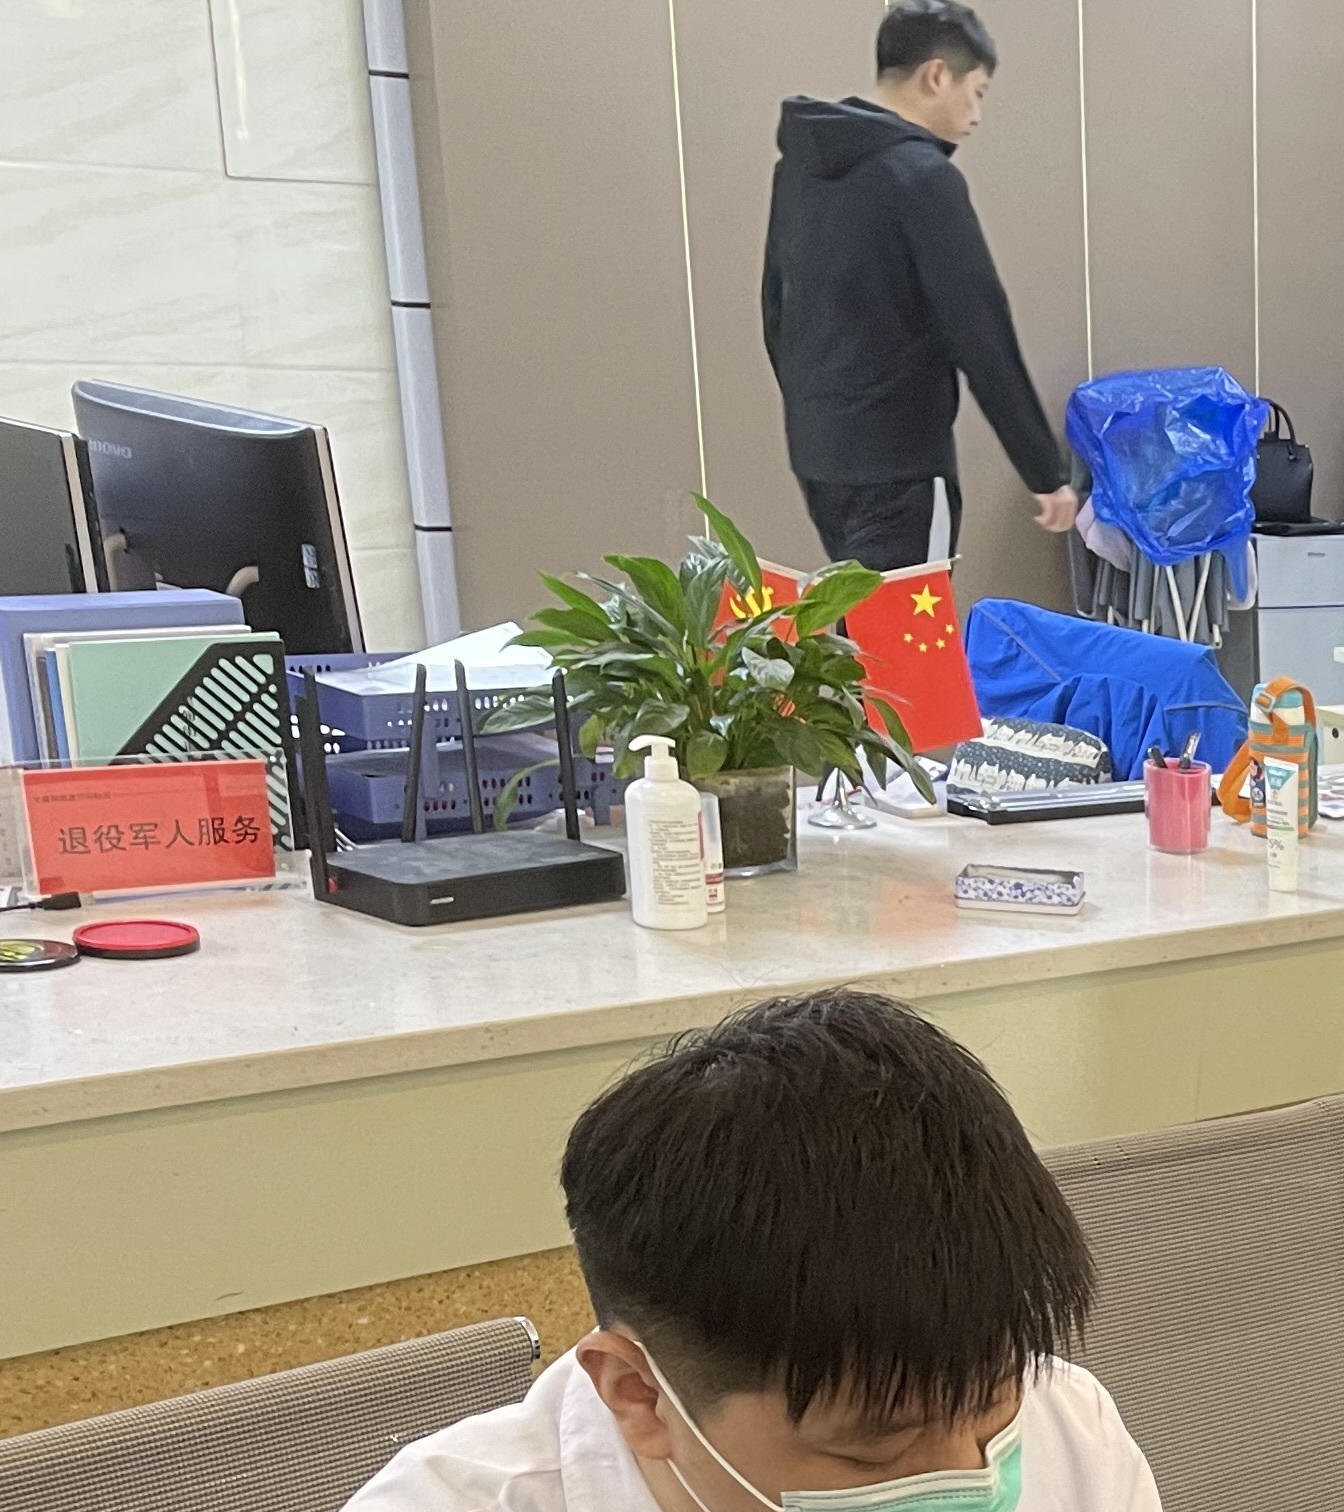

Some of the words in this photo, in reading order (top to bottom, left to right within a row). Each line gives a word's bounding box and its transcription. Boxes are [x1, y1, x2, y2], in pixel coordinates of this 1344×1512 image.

[58, 815, 261, 855] 退役军人服务
